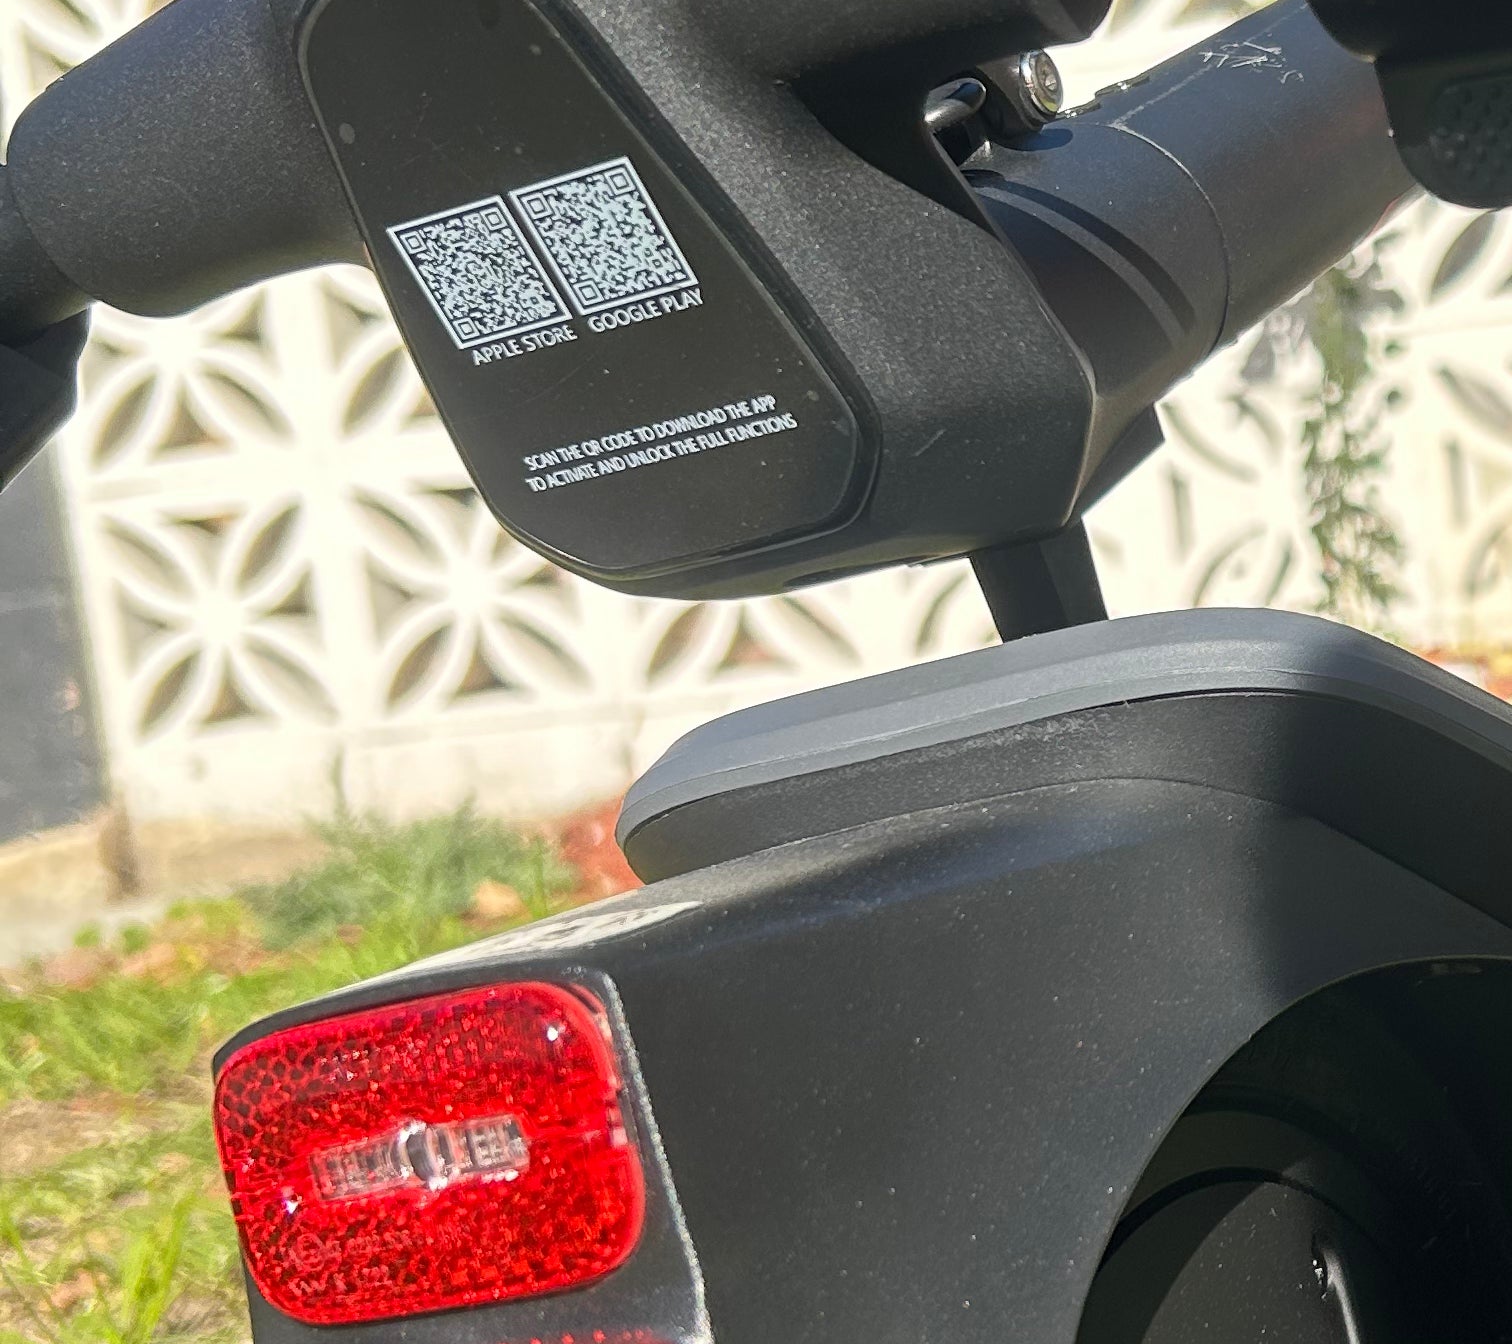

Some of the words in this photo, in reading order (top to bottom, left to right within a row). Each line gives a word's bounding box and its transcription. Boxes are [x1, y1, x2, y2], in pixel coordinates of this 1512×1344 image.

[586, 300, 662, 333] GOOGLE
[660, 287, 704, 313] PLAY
[471, 338, 524, 366] APPLE
[520, 324, 579, 353] STORE
[523, 450, 561, 471] SCAN
[556, 444, 585, 462] THE
[580, 439, 604, 457] QR
[600, 430, 639, 452] CODE
[633, 426, 656, 443] TO
[651, 407, 728, 439] DOWNLOAD
[723, 400, 753, 420] THE
[750, 394, 776, 414] APP
[524, 476, 547, 492] TO
[545, 462, 600, 489] ACTIVATE
[596, 456, 627, 476] AND
[622, 443, 677, 468] UNLOCK
[671, 437, 700, 456] THE
[696, 430, 730, 450] FULL
[724, 412, 798, 443] FUNCTIONS
